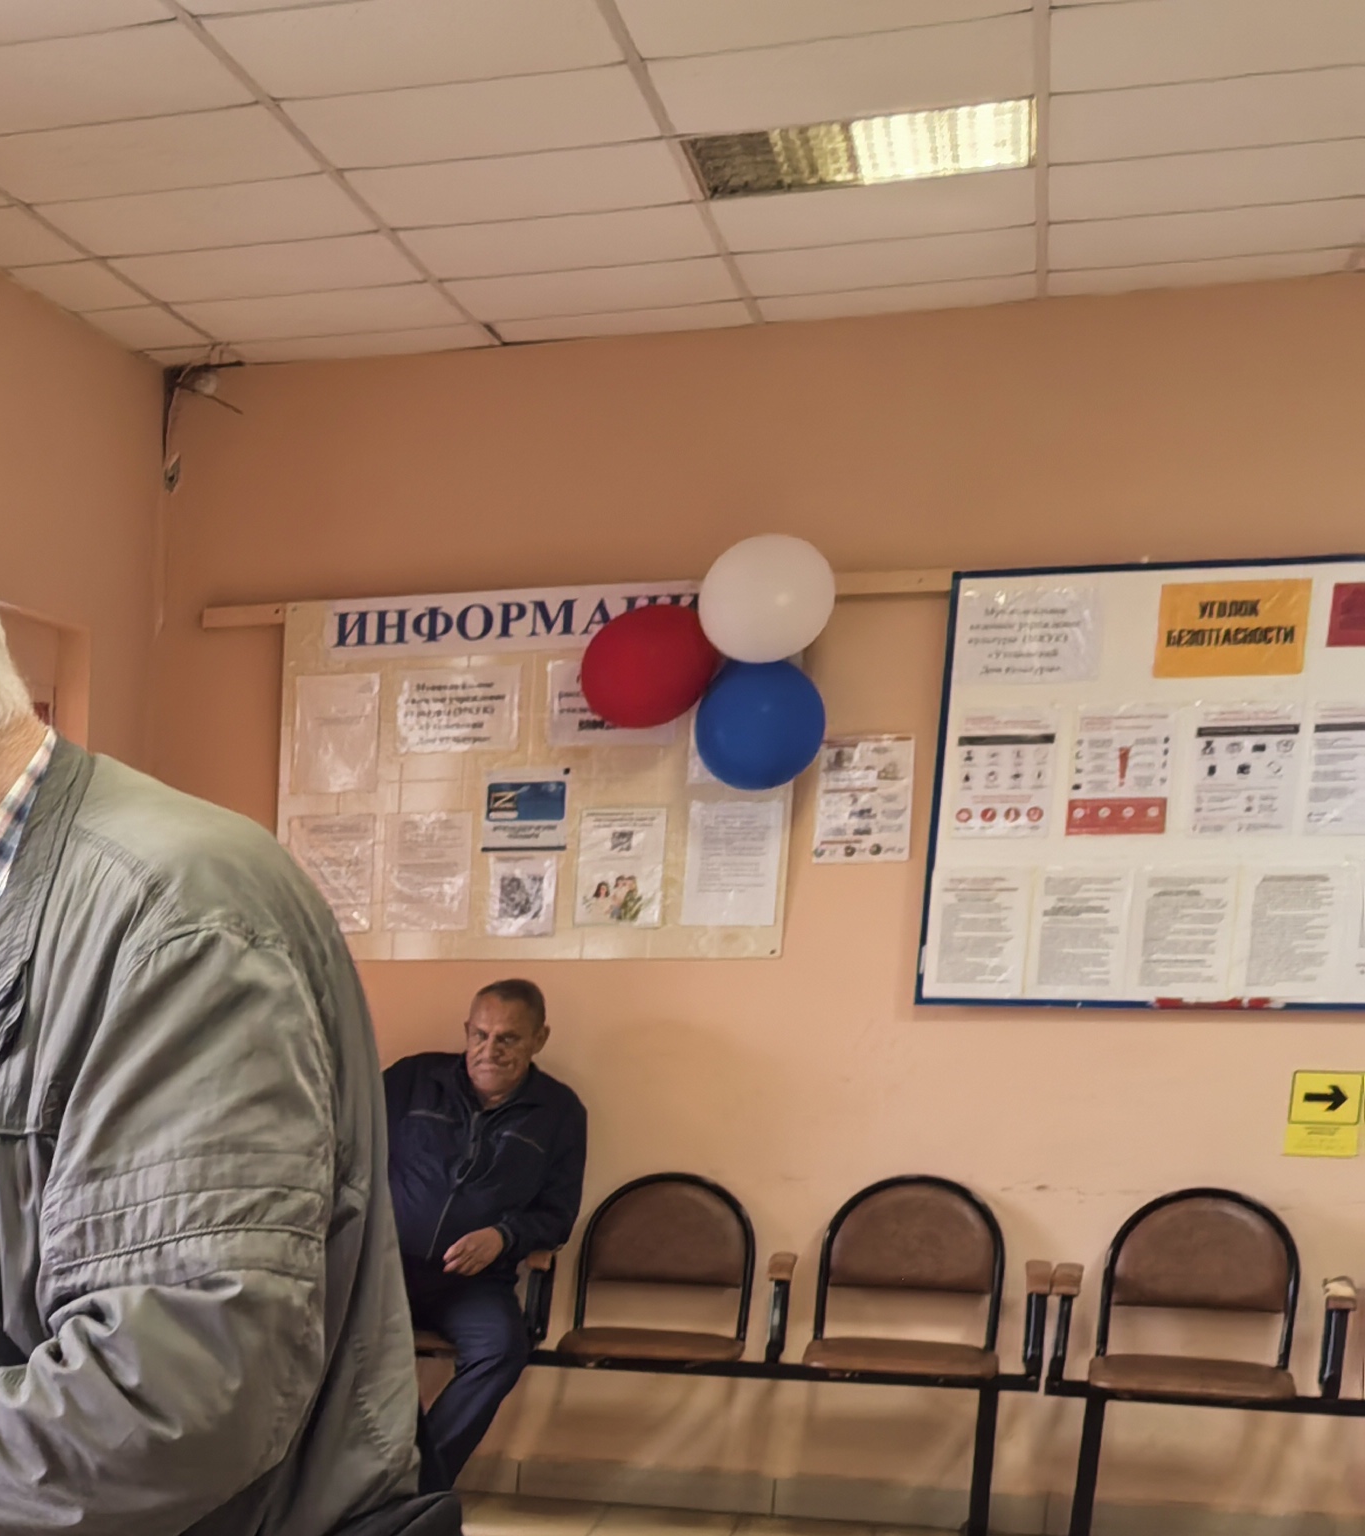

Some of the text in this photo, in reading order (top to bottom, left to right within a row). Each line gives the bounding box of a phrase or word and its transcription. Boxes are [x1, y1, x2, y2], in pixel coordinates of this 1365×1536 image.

[332, 594, 700, 648] ИНФОРМА
[1197, 599, 1262, 620] УГОЛОК
[1165, 625, 1296, 648] БЕЗОПАСНОСТИ
